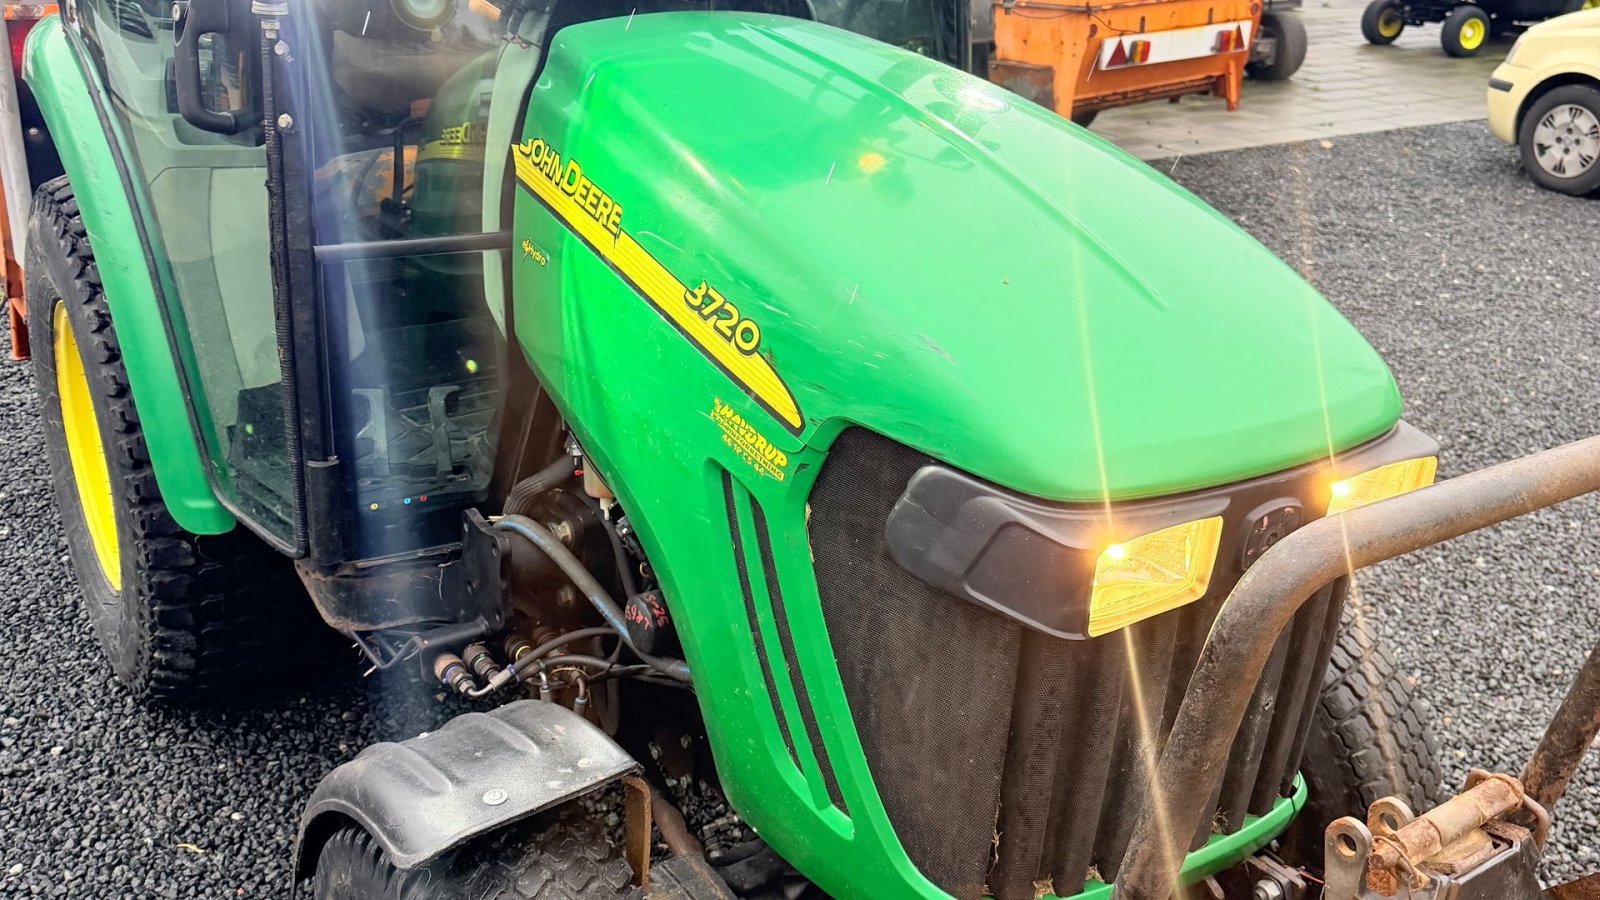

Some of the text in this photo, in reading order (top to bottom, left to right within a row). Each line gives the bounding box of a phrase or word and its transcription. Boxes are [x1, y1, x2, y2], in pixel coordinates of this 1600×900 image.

[519, 138, 623, 235] JOHN DEERE
[684, 280, 760, 356] 3720
